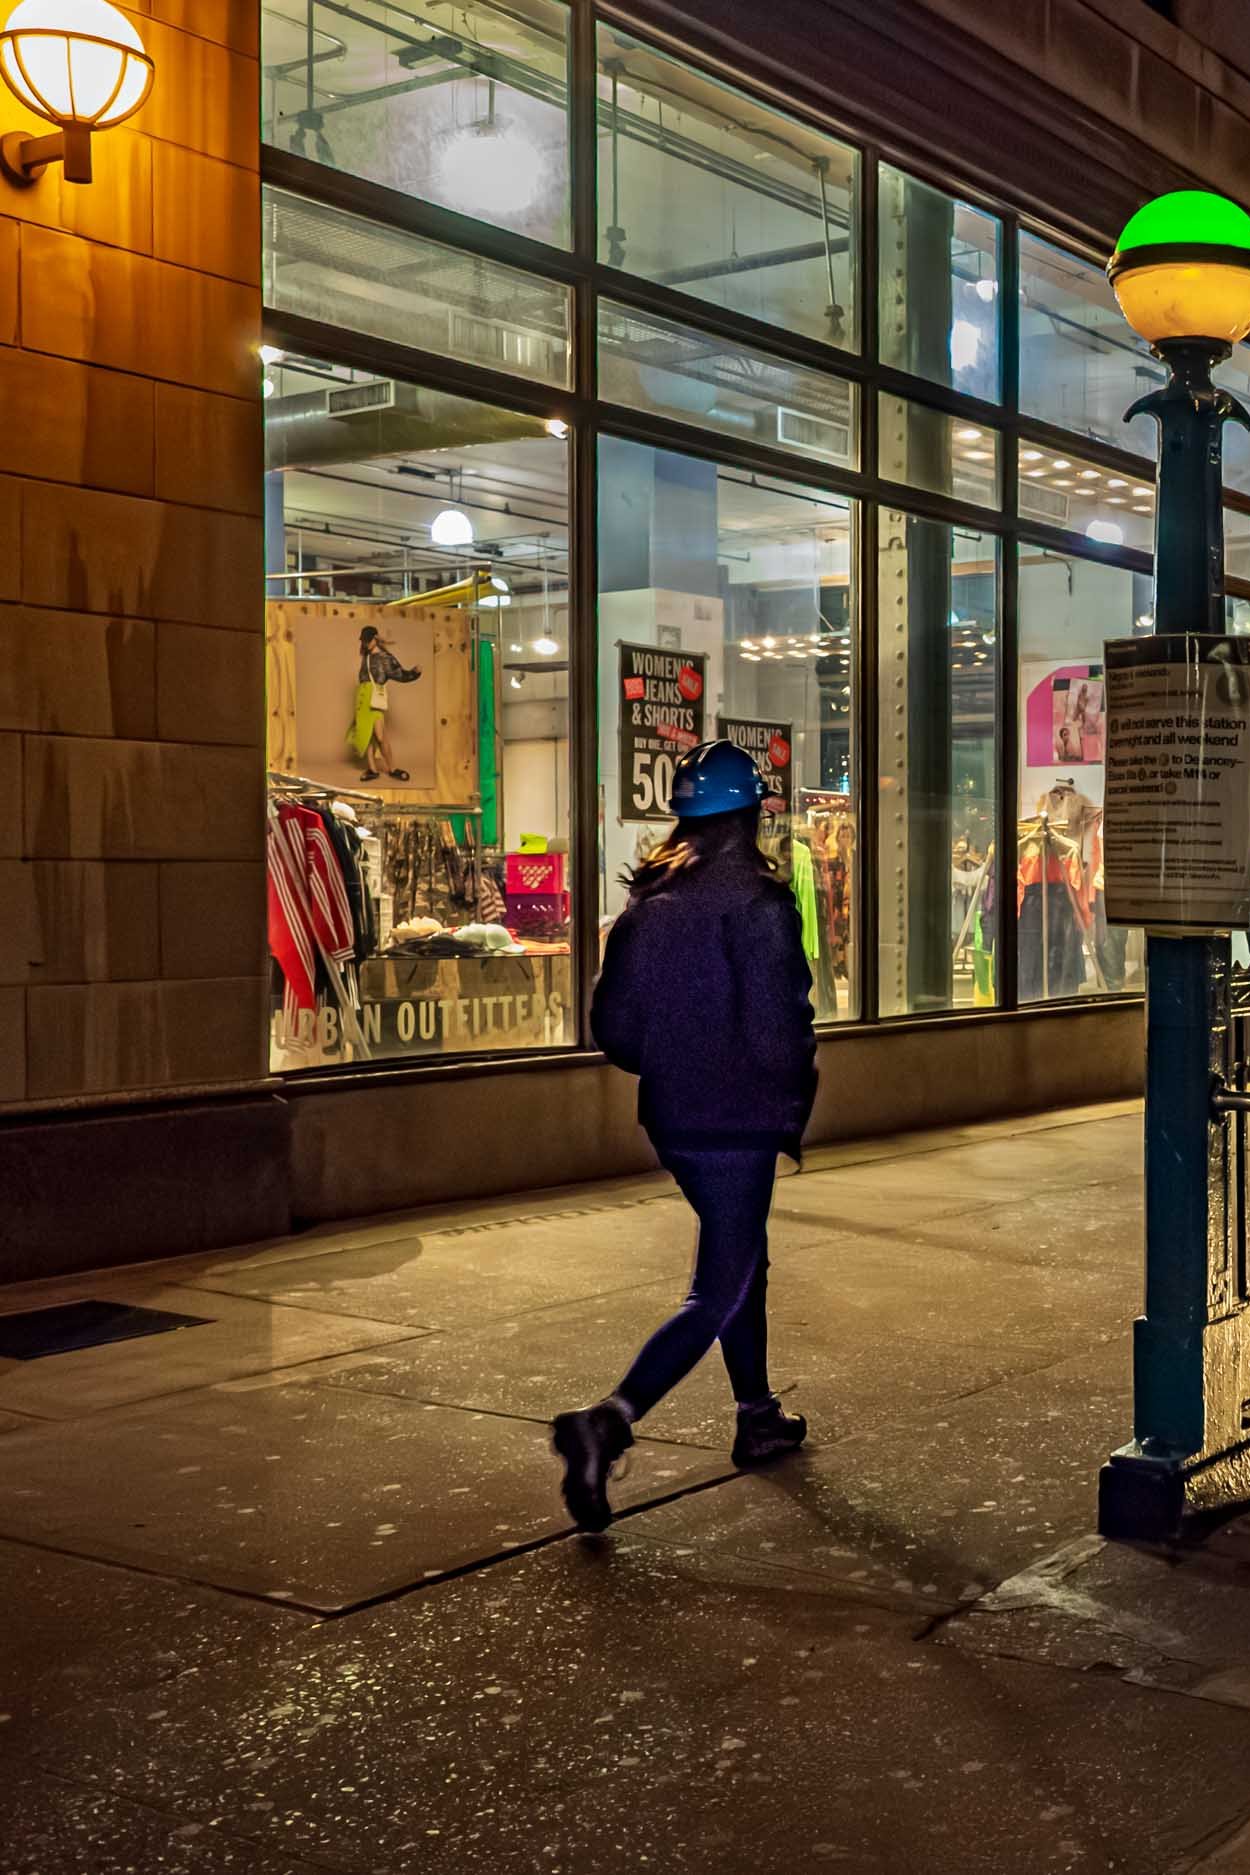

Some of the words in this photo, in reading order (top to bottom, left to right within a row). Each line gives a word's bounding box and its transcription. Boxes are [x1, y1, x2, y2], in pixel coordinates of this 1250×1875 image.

[644, 680, 682, 704] JEANS
[632, 703, 641, 725] &
[644, 704, 694, 731] SHORTS
[1176, 715, 1199, 728] this
[1203, 717, 1247, 731] station
[633, 752, 680, 813] 50
